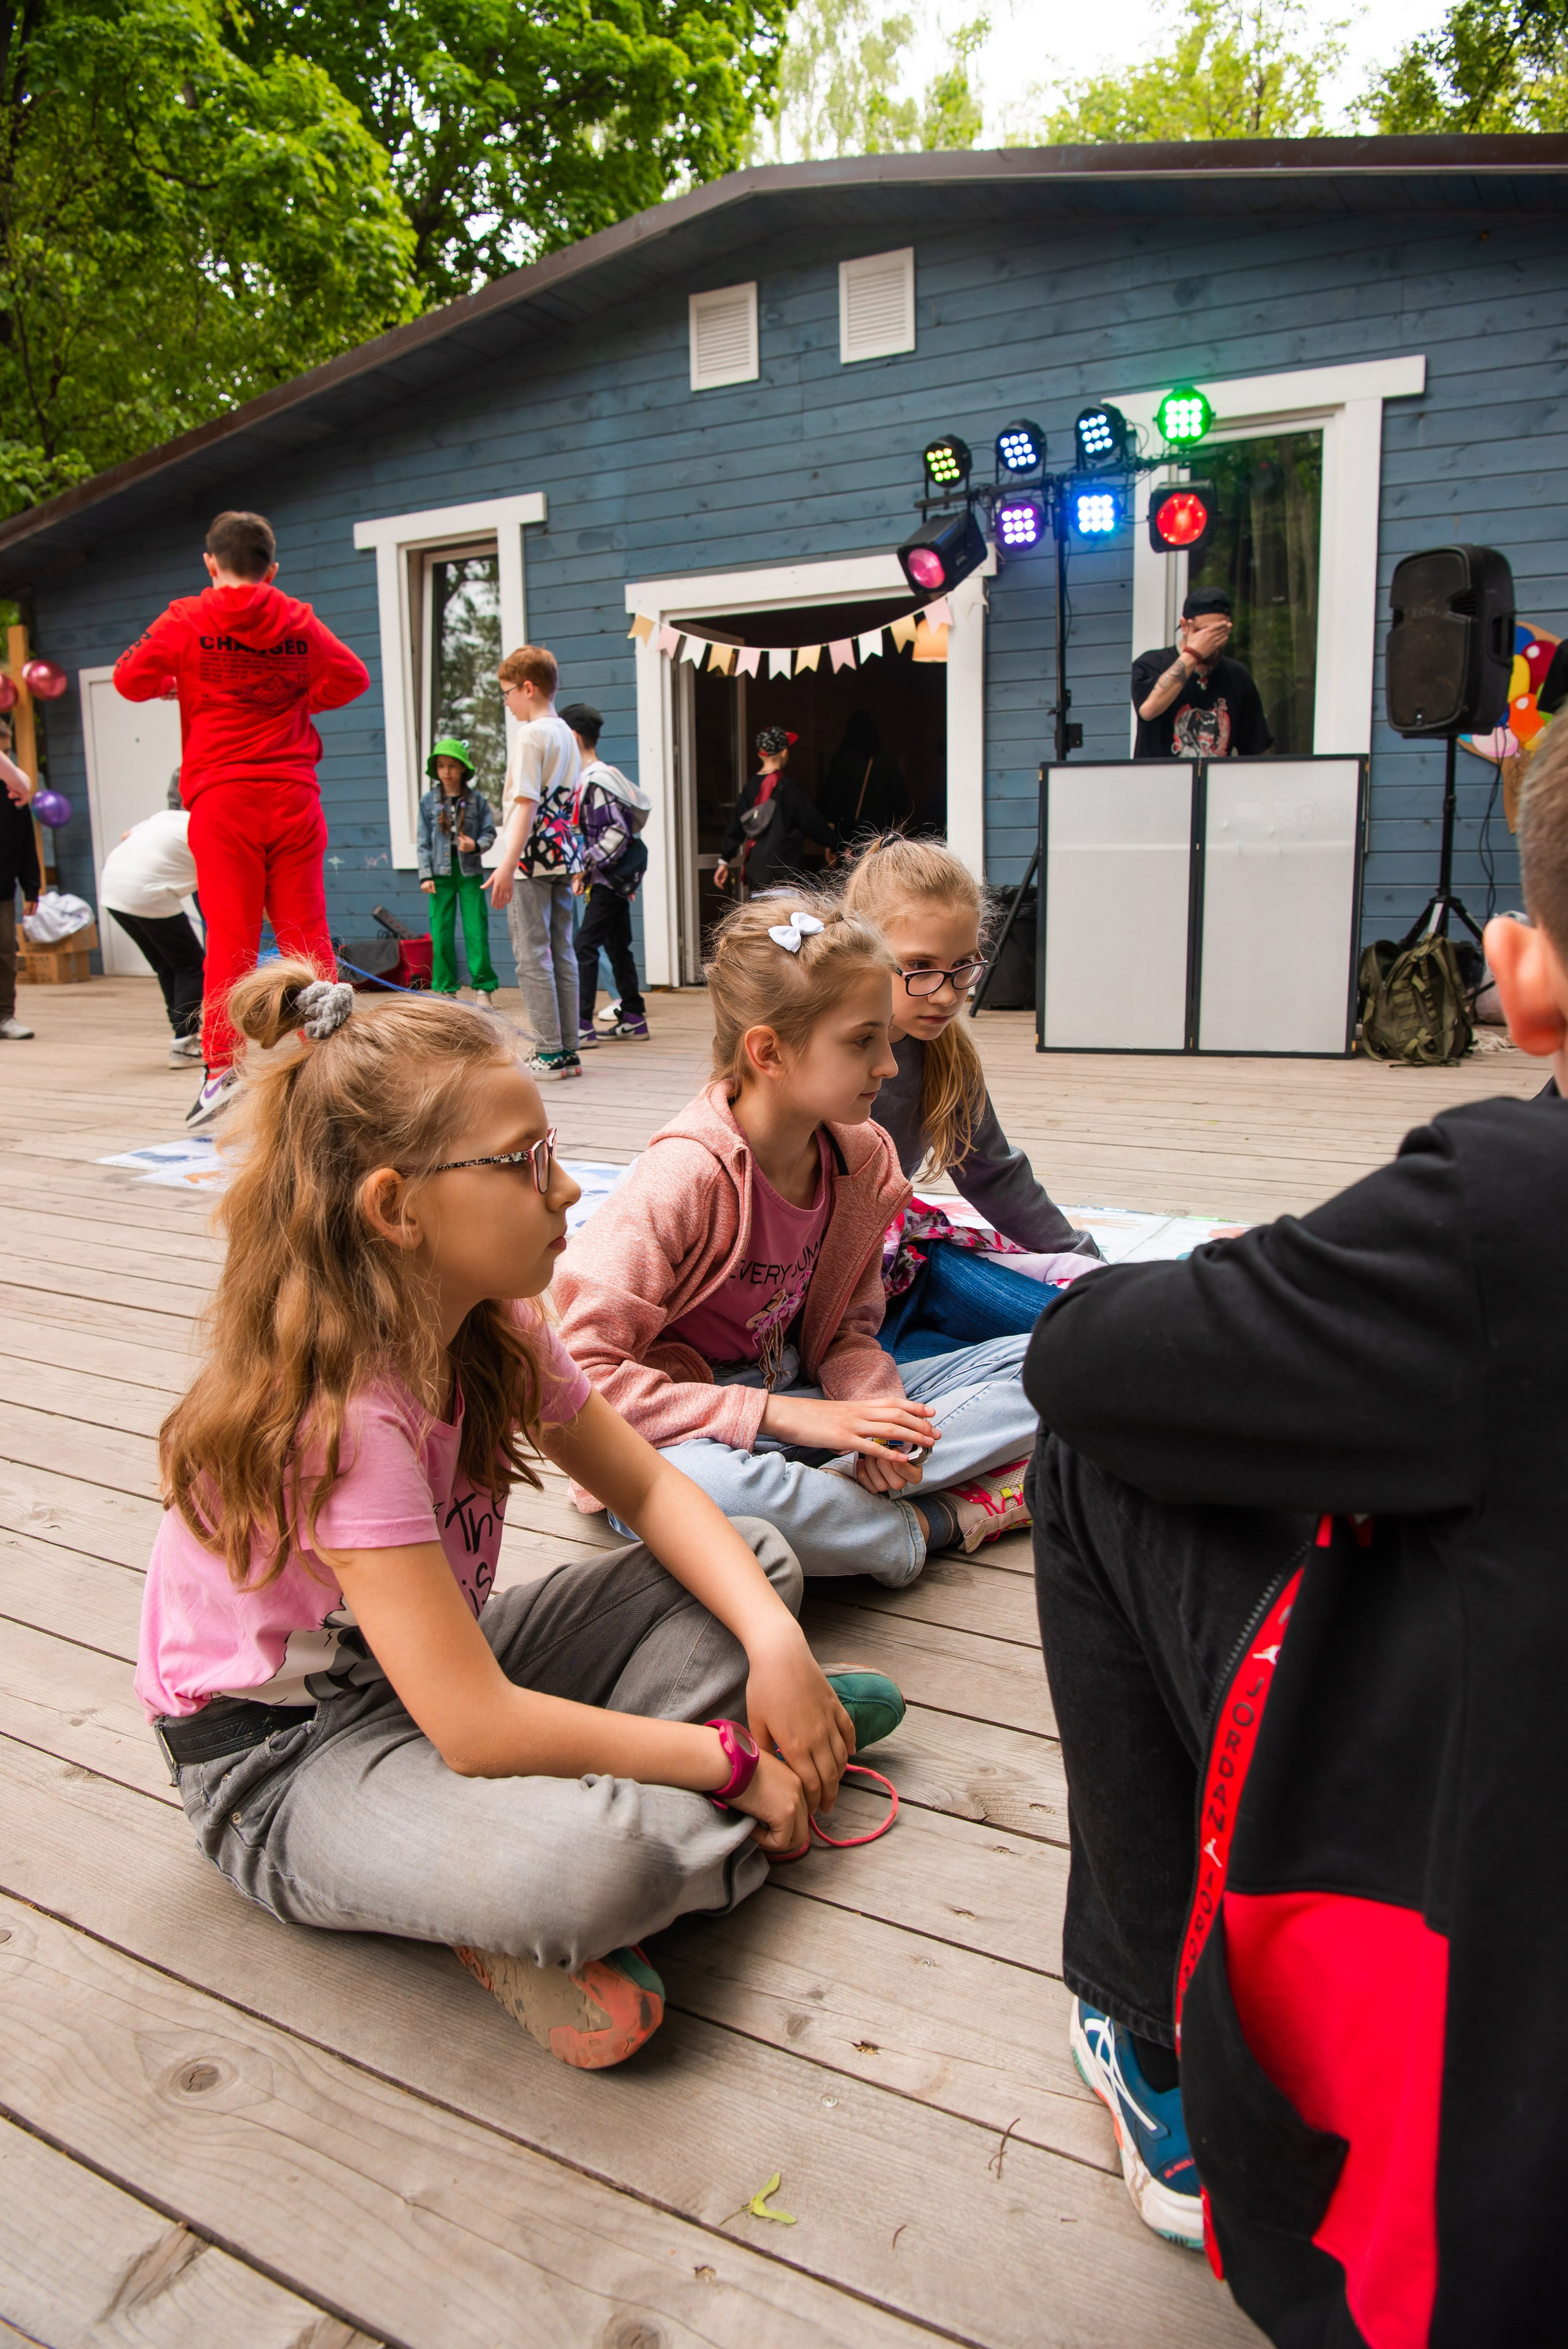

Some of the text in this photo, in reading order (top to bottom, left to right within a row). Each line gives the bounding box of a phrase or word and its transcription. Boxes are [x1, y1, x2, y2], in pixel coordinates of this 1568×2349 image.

[200, 635, 309, 655] CHAGED
[462, 1561, 492, 1617] is
[1207, 1676, 1265, 1833] JORDAN
